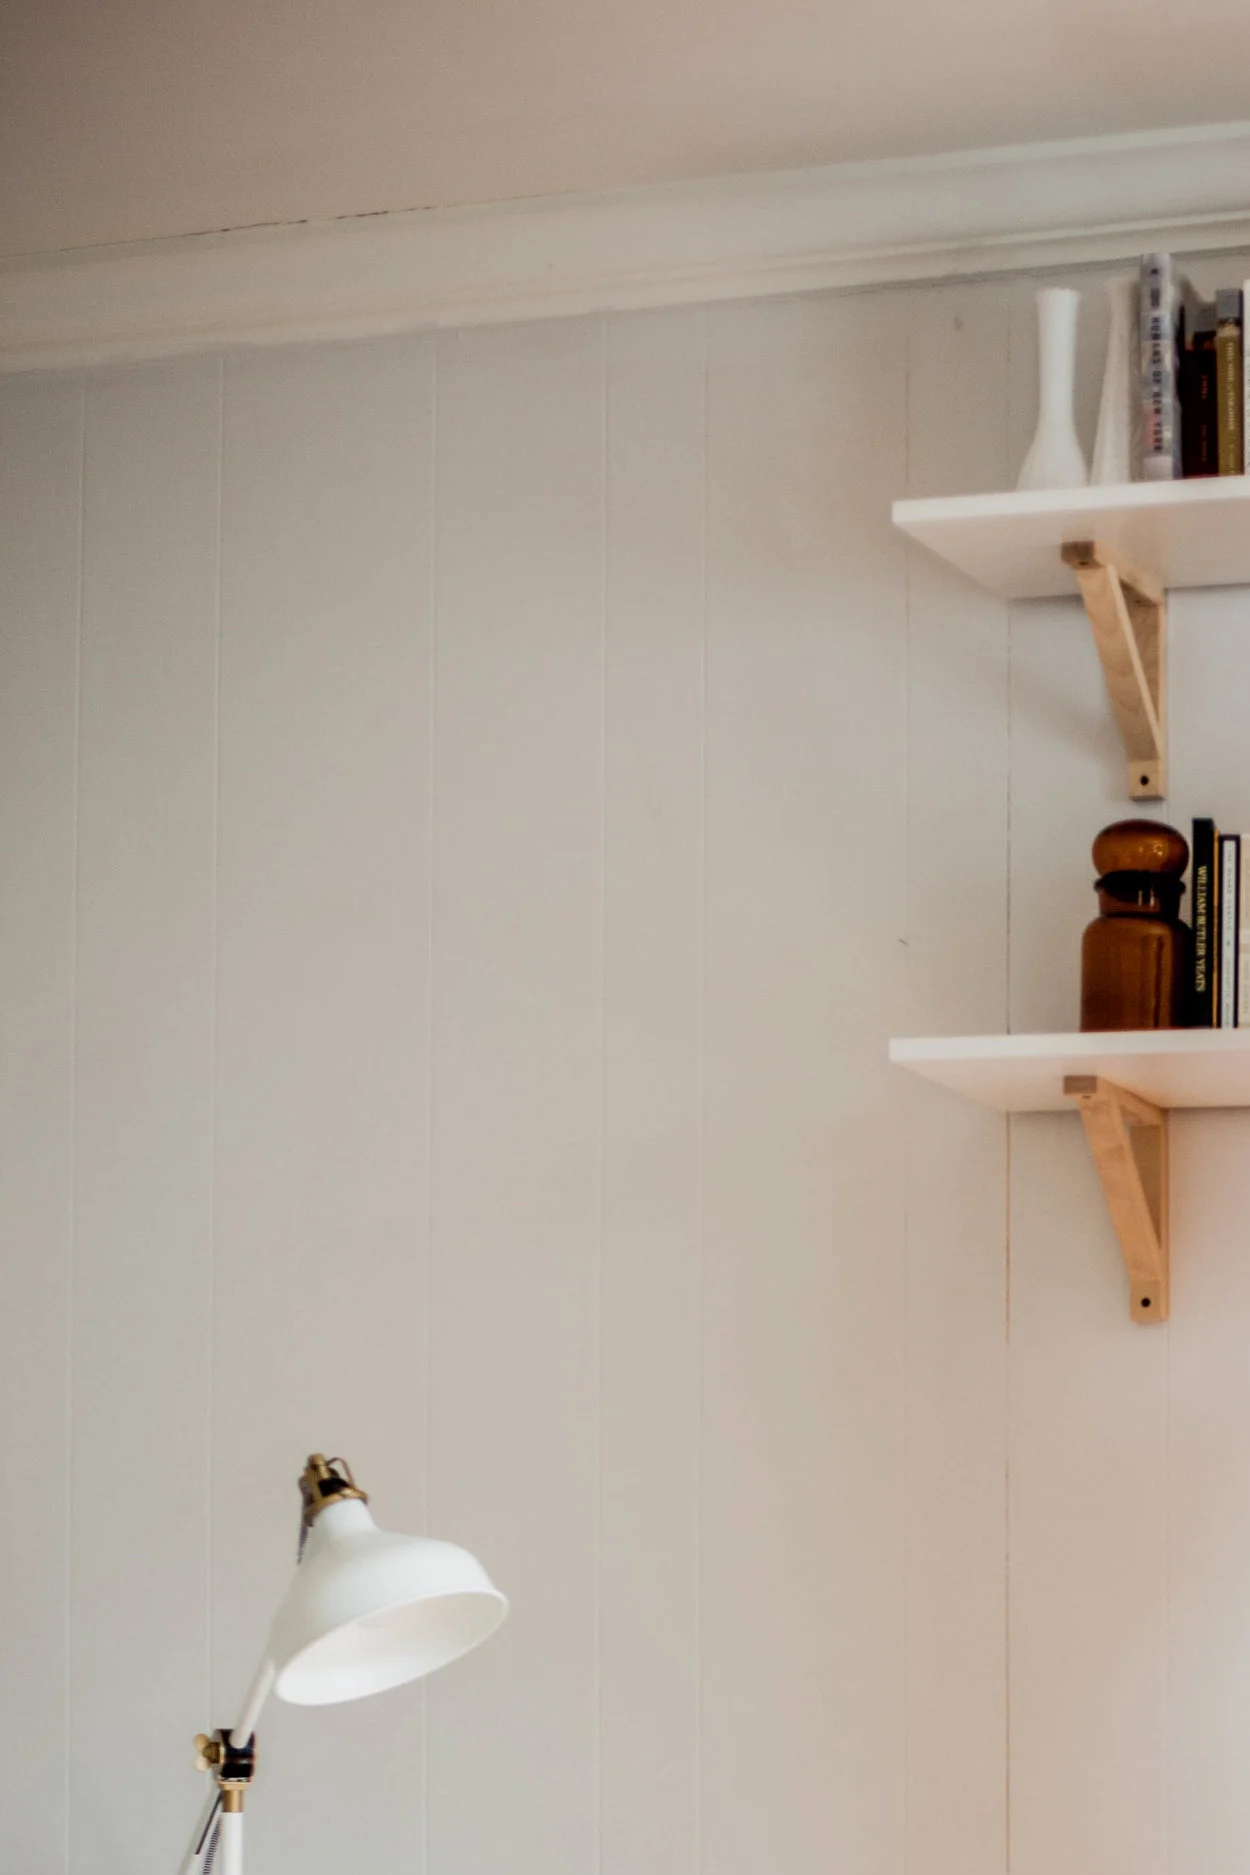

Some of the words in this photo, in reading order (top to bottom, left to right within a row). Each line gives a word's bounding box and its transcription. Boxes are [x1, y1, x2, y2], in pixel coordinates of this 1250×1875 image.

[1151, 317, 1162, 364] HUMANS
[1151, 371, 1163, 386] OF
[1196, 866, 1207, 914] WILLIAM
[1196, 916, 1207, 956] BUTLER
[1195, 958, 1207, 992] YEATS
